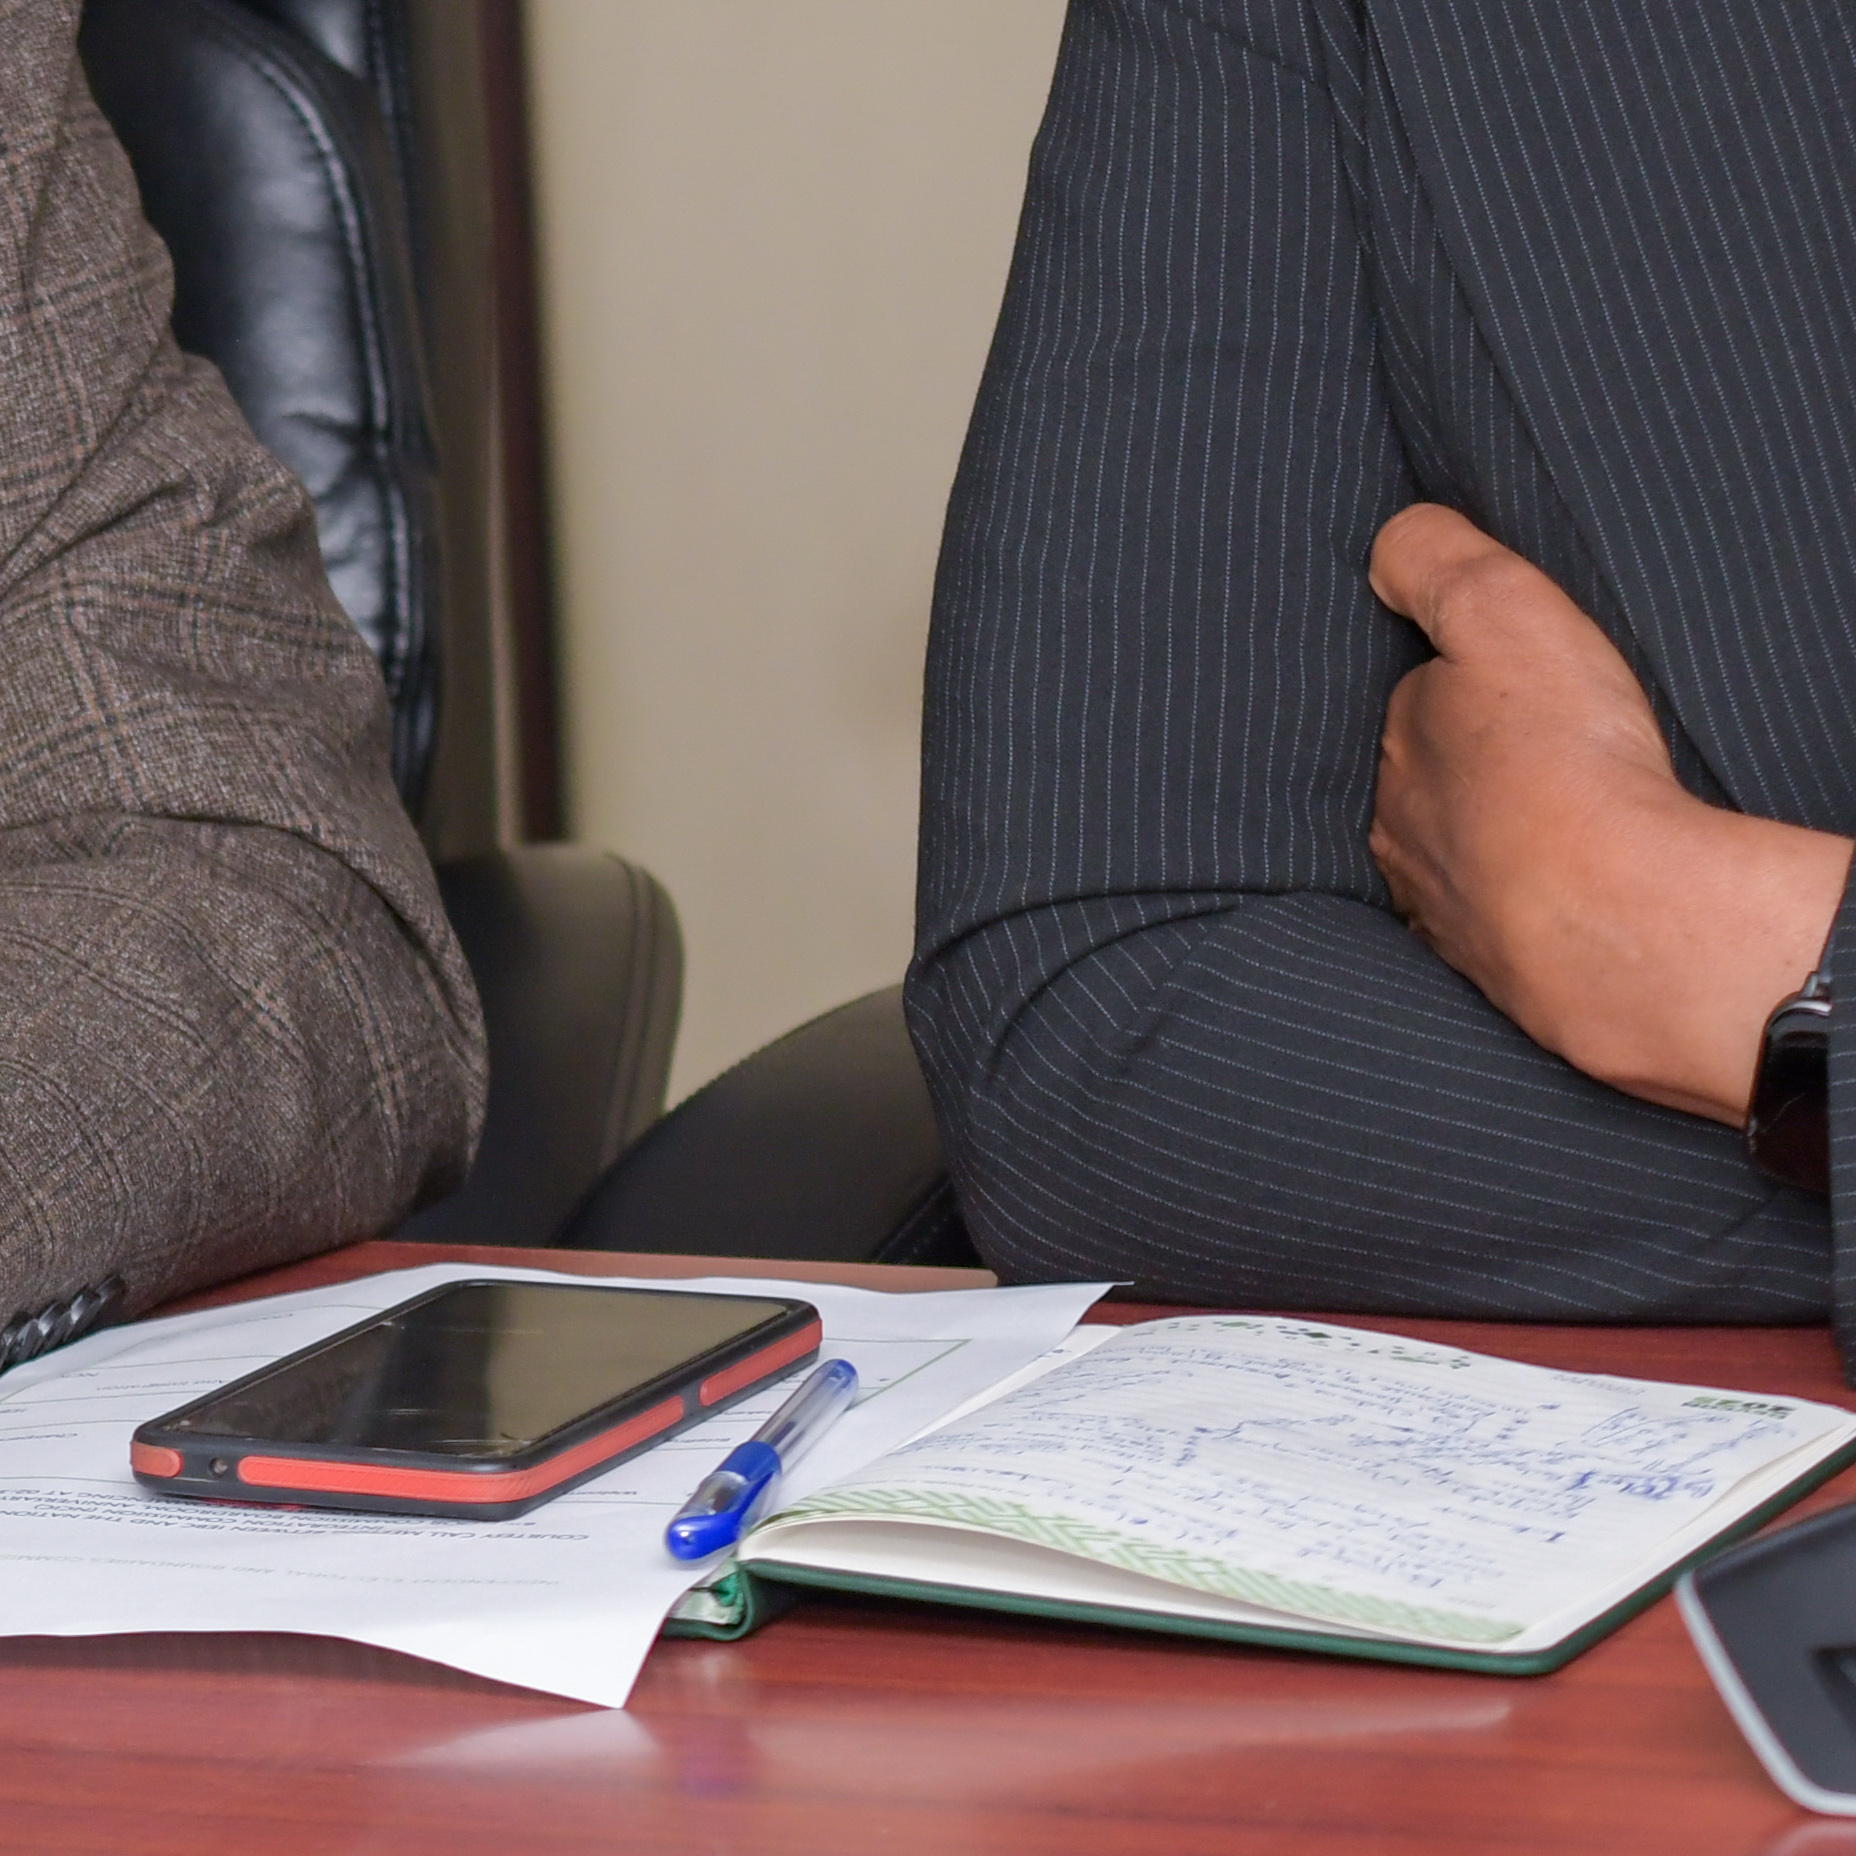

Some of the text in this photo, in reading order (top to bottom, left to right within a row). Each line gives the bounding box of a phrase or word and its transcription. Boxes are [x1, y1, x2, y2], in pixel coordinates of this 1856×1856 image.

[83, 1514, 123, 1523] THE
[101, 1509, 238, 1524] COMMISSION
[289, 1515, 425, 1526] COMMISSION
[129, 1519, 178, 1527] AND
[242, 1519, 385, 1532] INTEGRATION
[229, 1526, 326, 1535] BETWEEN
[429, 1531, 477, 1539] CALL
[478, 1533, 590, 1541] COURTESY
[89, 1557, 227, 1571] BOUNDARIES
[231, 1566, 276, 1574] AND
